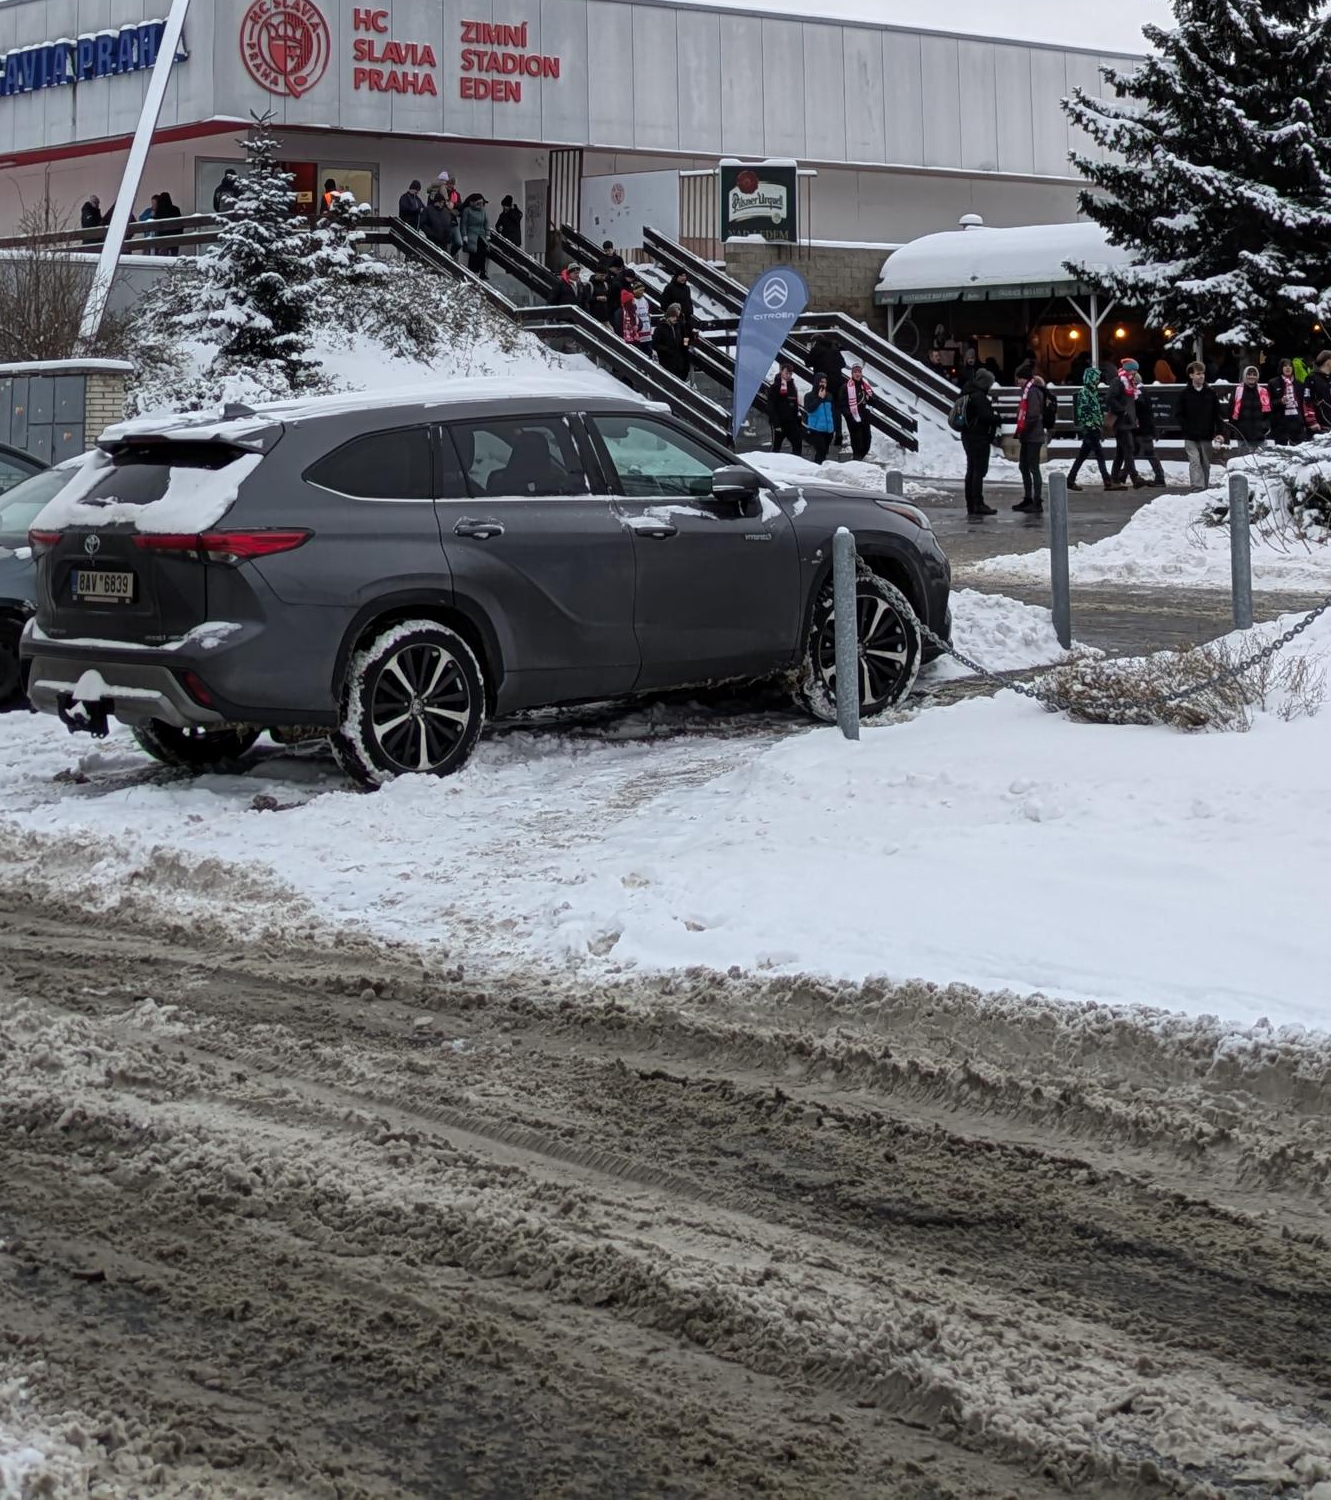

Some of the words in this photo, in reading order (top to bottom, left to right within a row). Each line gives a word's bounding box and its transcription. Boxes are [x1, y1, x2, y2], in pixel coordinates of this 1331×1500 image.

[353, 7, 388, 33] HC
[460, 19, 529, 48] ZIMNÍ
[247, 42, 279, 86] PRAHA
[353, 38, 437, 68] SLAVIA
[460, 48, 560, 78] STADION
[354, 67, 437, 96] PRAHA
[459, 77, 522, 102] EDEN
[79, 574, 97, 592] 8AV
[104, 574, 129, 594] 6839
